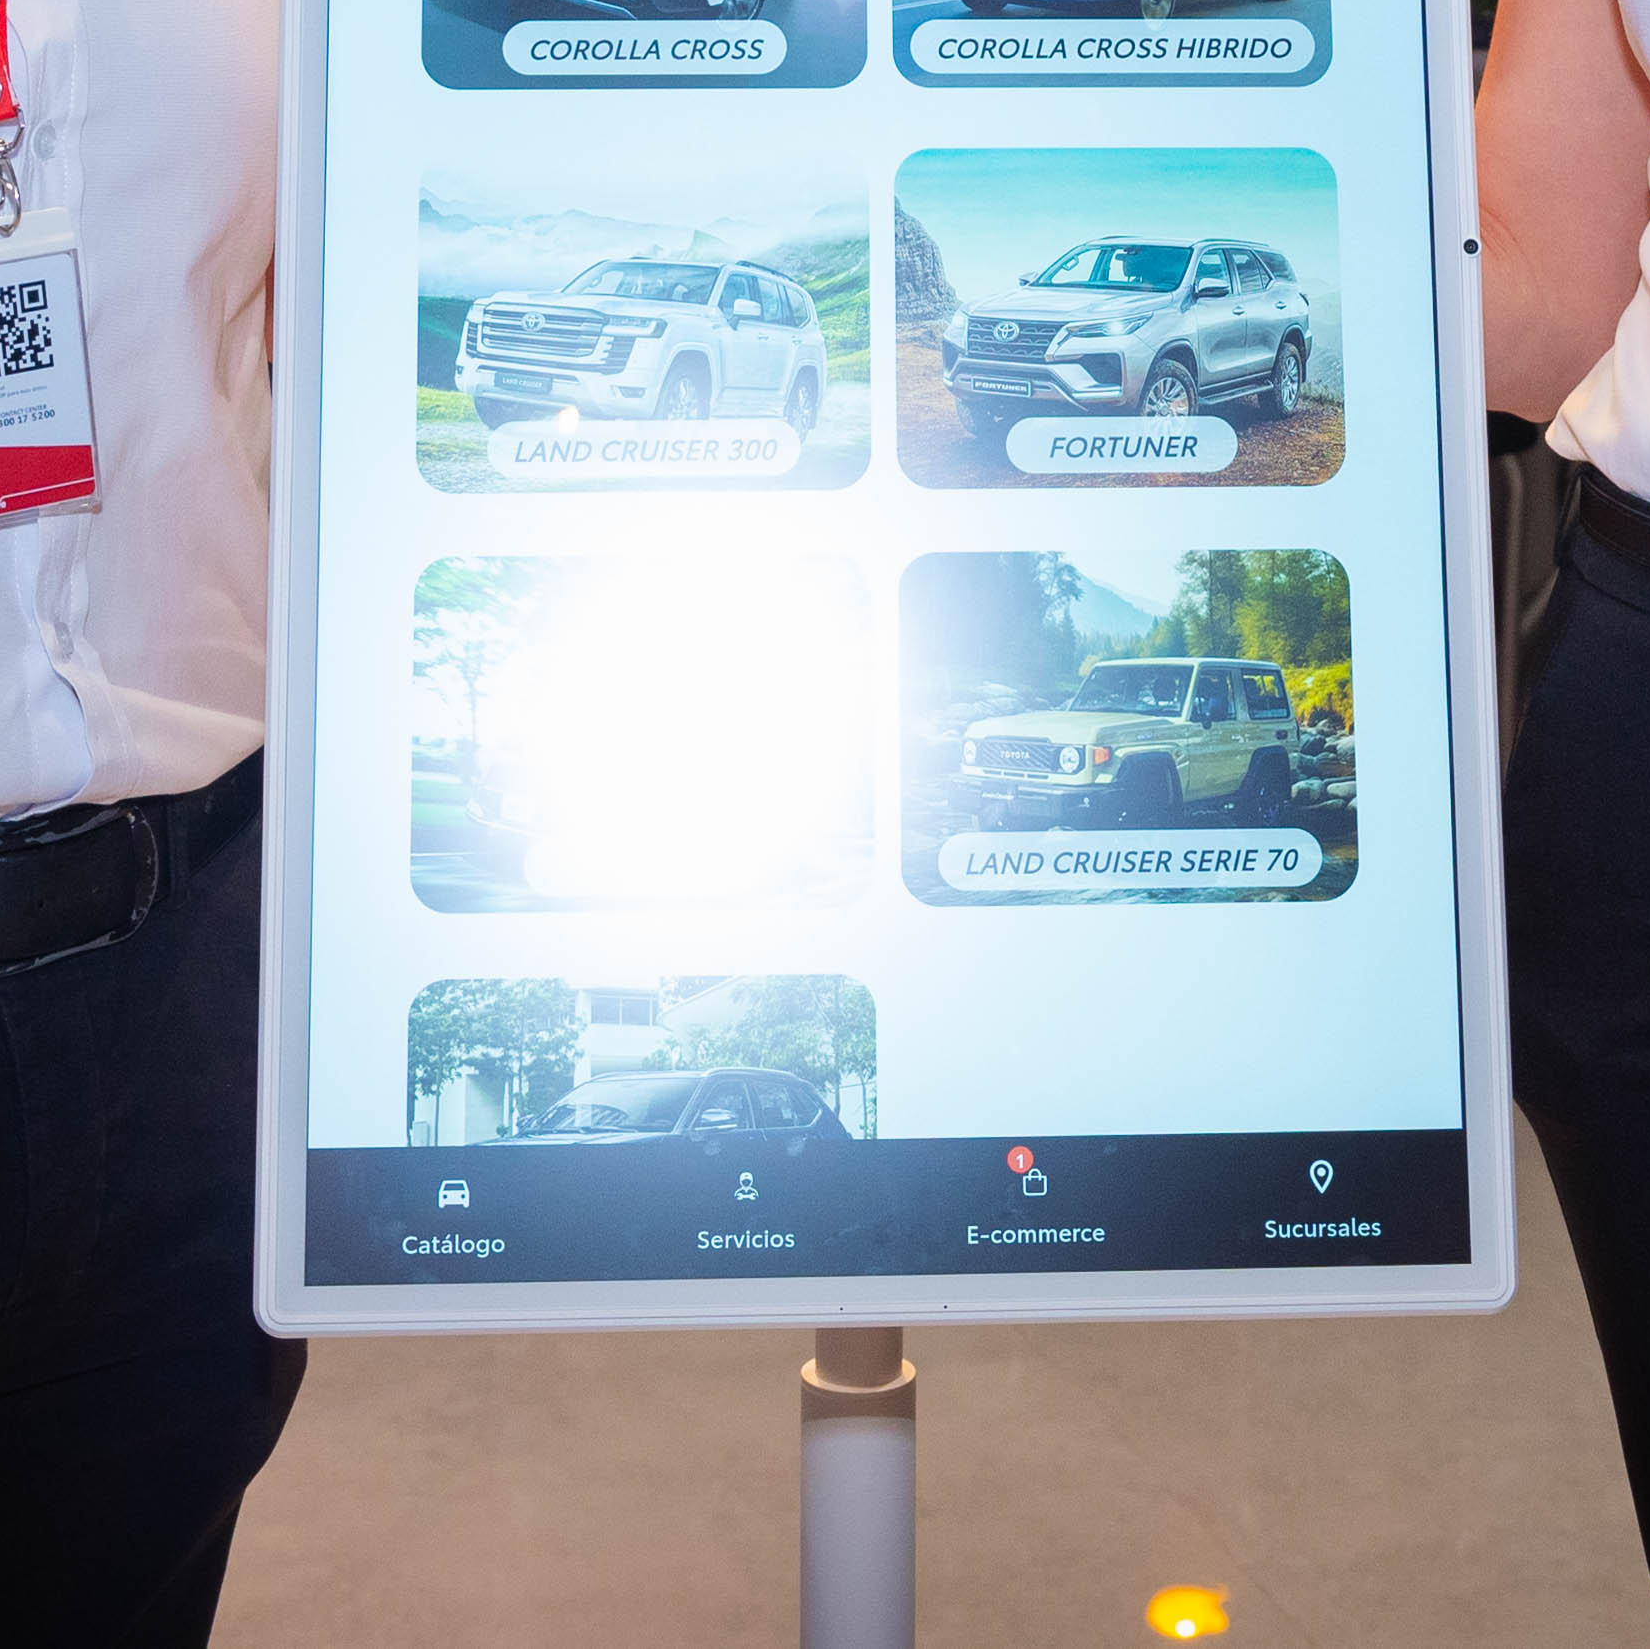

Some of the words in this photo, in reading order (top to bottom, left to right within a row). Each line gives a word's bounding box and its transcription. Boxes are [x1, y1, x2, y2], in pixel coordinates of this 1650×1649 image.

[529, 38, 662, 61] COROLLA
[670, 38, 765, 61] CROSS
[936, 37, 1066, 60] COROLLA
[1075, 37, 1168, 60] CROSS
[1175, 37, 1293, 59] HIBRIDO
[17, 414, 28, 424] 17
[31, 409, 56, 421] 5200
[514, 439, 593, 463] LAND
[600, 439, 721, 463] CRUISER
[727, 438, 778, 462] 300
[1049, 435, 1199, 459] FORTUNER
[966, 851, 1044, 876] LAND
[1052, 850, 1172, 875] CRUISER
[1180, 849, 1258, 873] SERIE
[1265, 848, 1299, 872] 70
[1015, 1152, 1026, 1170] 1
[966, 1224, 1106, 1245] E-commerce
[1264, 1217, 1382, 1239] Sucursales
[402, 1233, 506, 1258] Catálogo
[697, 1229, 795, 1251] Servicios
